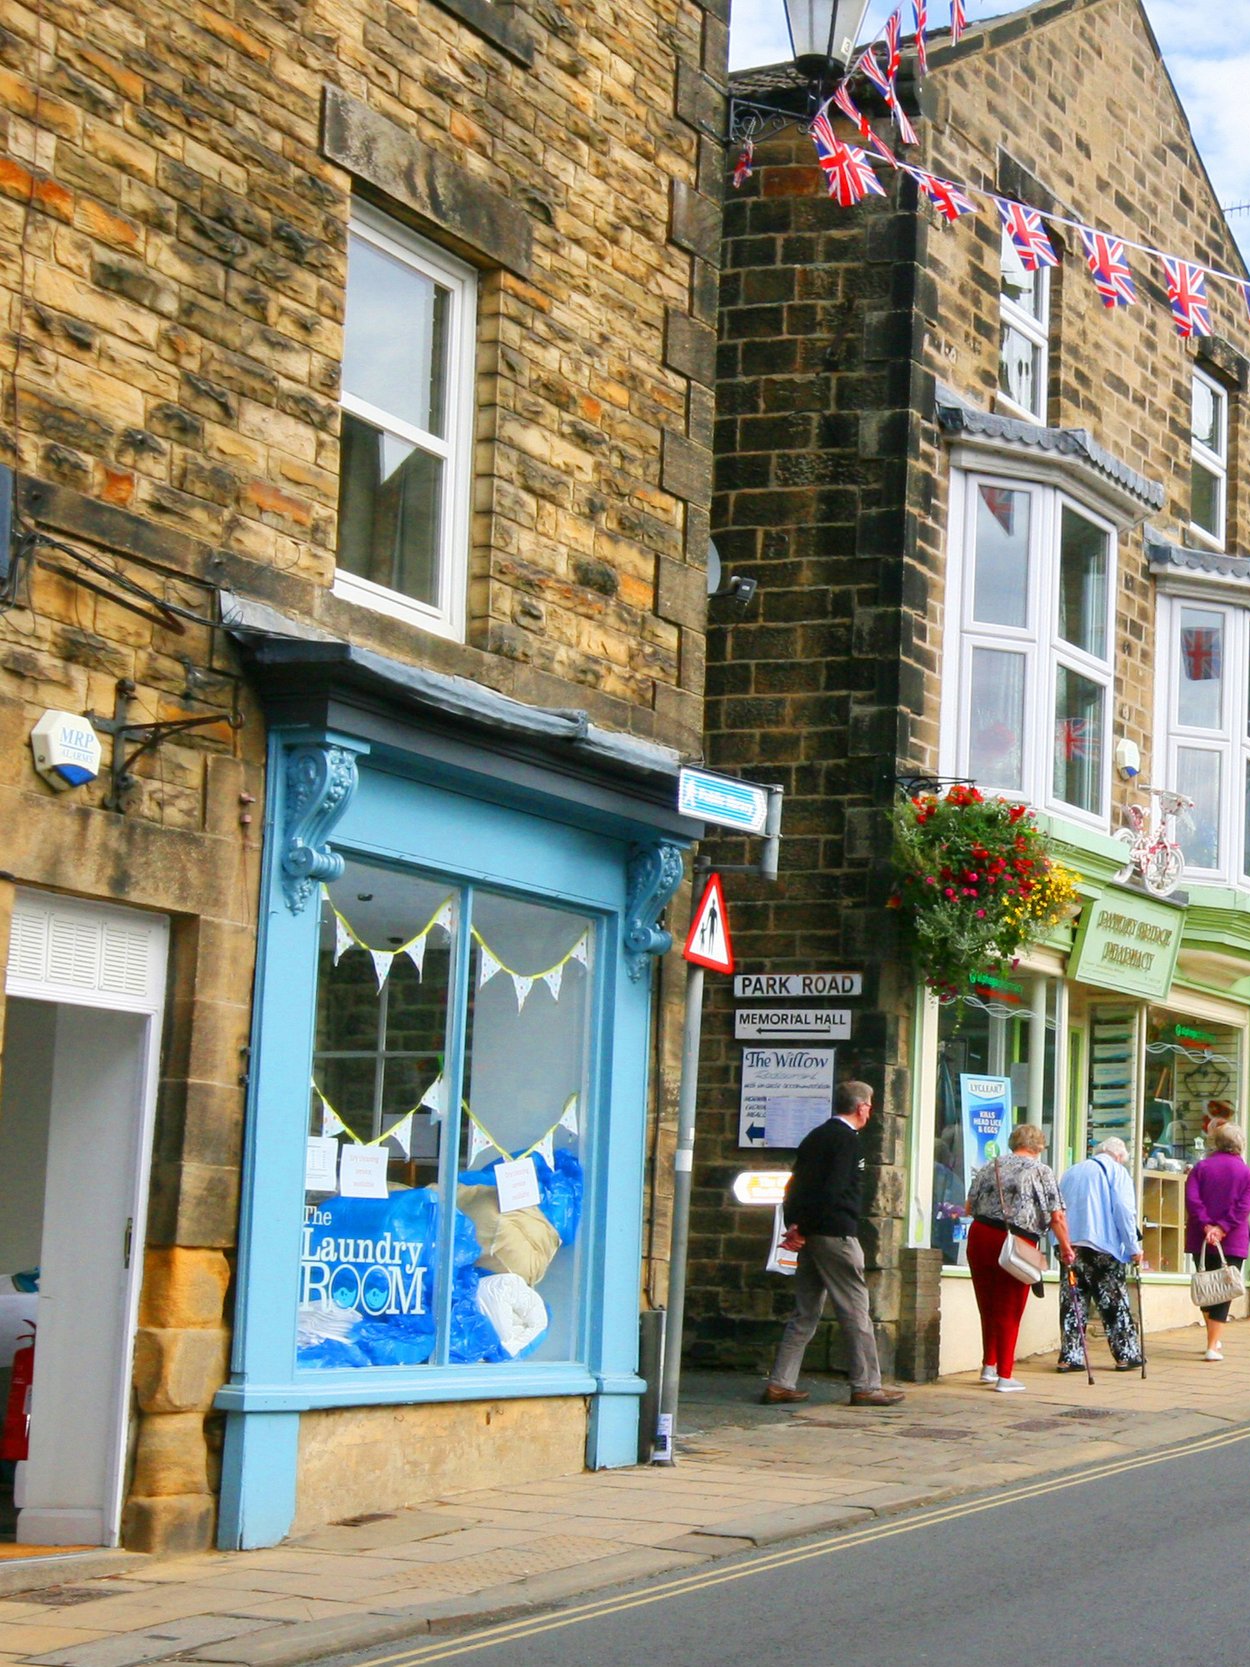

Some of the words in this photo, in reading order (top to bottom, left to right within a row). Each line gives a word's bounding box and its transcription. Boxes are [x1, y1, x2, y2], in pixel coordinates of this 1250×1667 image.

[60, 727, 94, 748] MRP
[742, 977, 791, 994] PARK
[802, 976, 854, 993] ROAD
[739, 1014, 811, 1025] MEMORIAL
[815, 1014, 846, 1025] HALL
[745, 1051, 771, 1067] The
[772, 1051, 828, 1068] Willow
[973, 1118, 989, 1126] HEAD
[980, 1111, 995, 1119] KILLS
[303, 1205, 332, 1226] The
[301, 1227, 423, 1275] Laundry
[299, 1261, 427, 1316] ROOM
